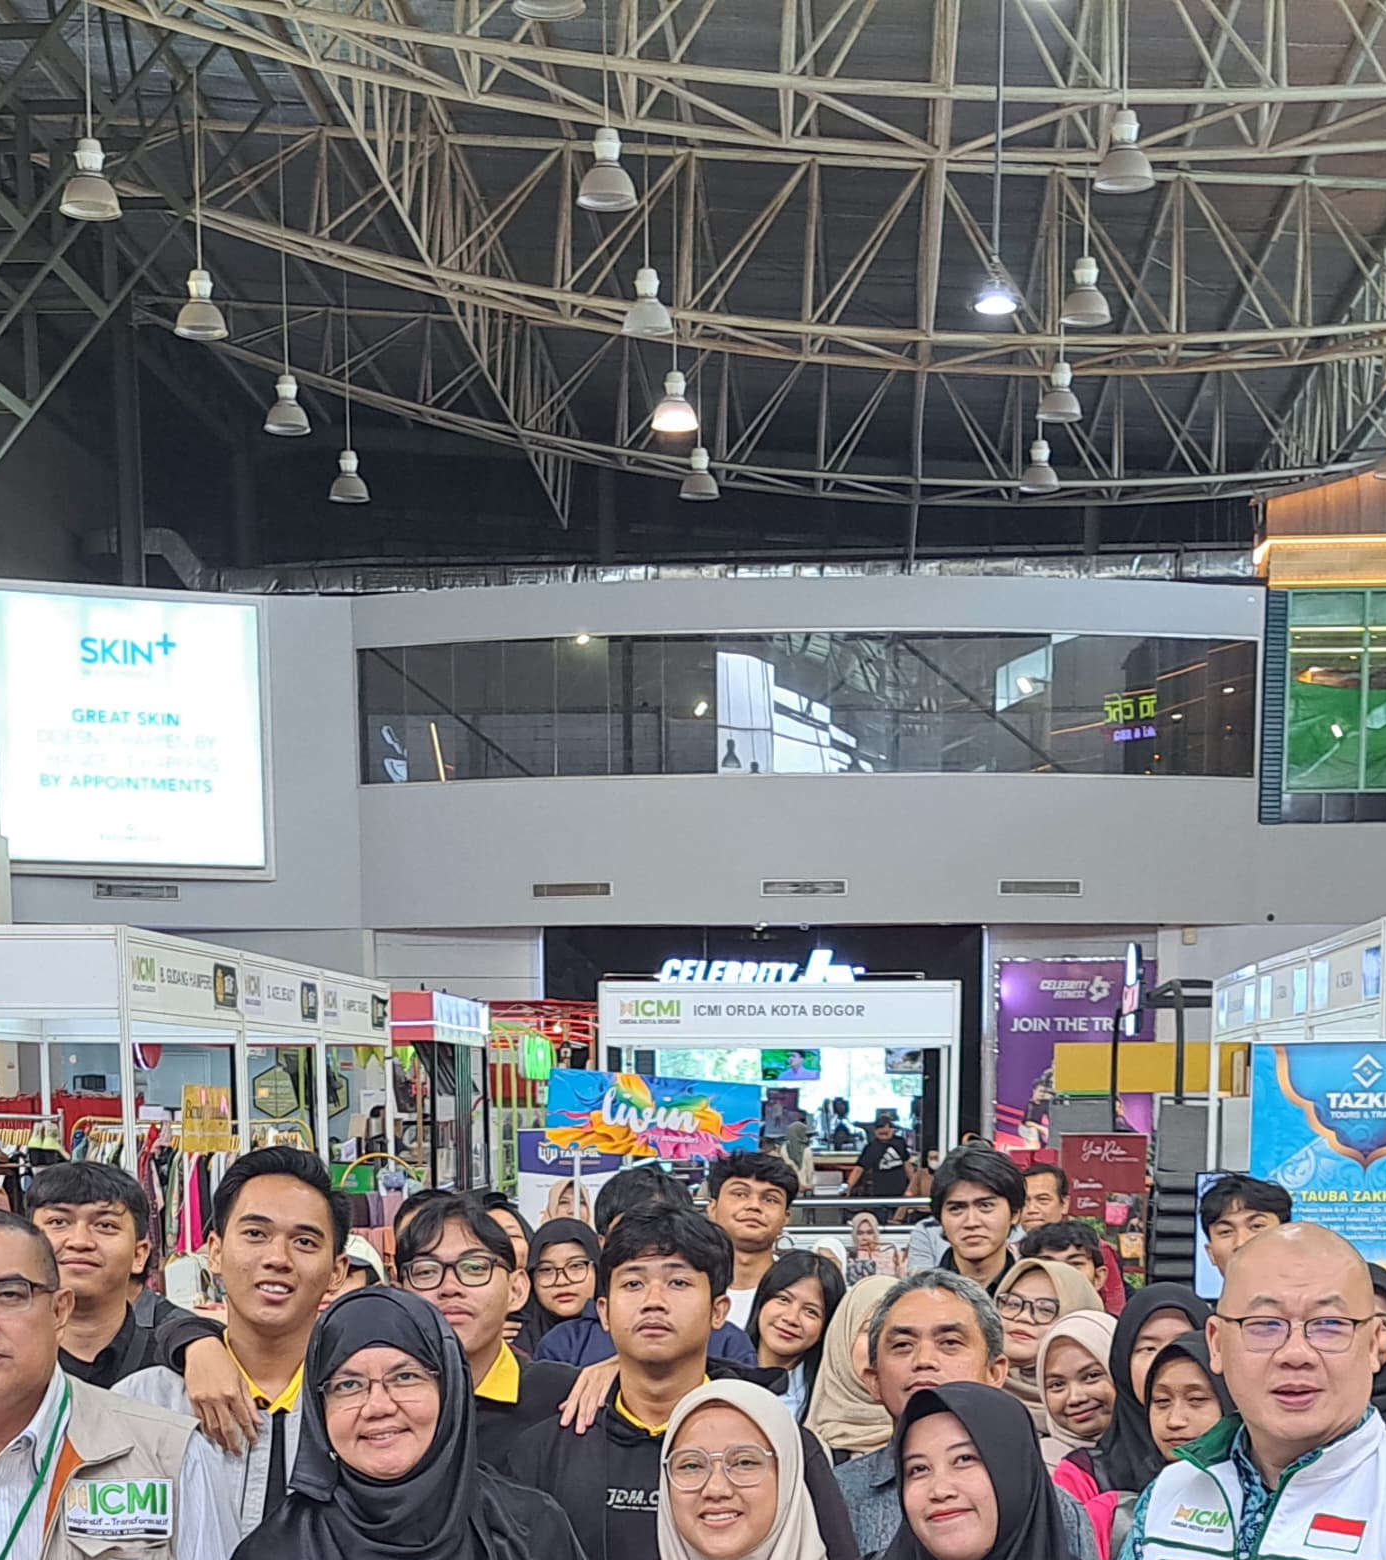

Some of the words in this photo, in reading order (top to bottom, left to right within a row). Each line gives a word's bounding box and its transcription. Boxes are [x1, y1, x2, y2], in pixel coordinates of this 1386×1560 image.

[71, 709, 131, 724] GREAT
[138, 712, 181, 727] SKIN
[39, 773, 62, 787] BY
[69, 774, 213, 793] APPOINTMENTS
[659, 958, 799, 983] CELEBRITY
[1039, 979, 1090, 990] CELEBRITY
[635, 1000, 681, 1017] ICMI
[693, 1005, 722, 1017] ICMI
[726, 1005, 767, 1017] ORDA
[771, 1005, 808, 1017] KOTA
[813, 1005, 866, 1017] BOGOR
[1010, 1017, 1050, 1032] JOIN
[1053, 1017, 1089, 1031] THE
[1331, 1111, 1360, 1119] TOURS
[1301, 1190, 1349, 1202] TAUBA
[88, 1482, 167, 1515] ICMI
[1187, 1508, 1229, 1527] ICMI
